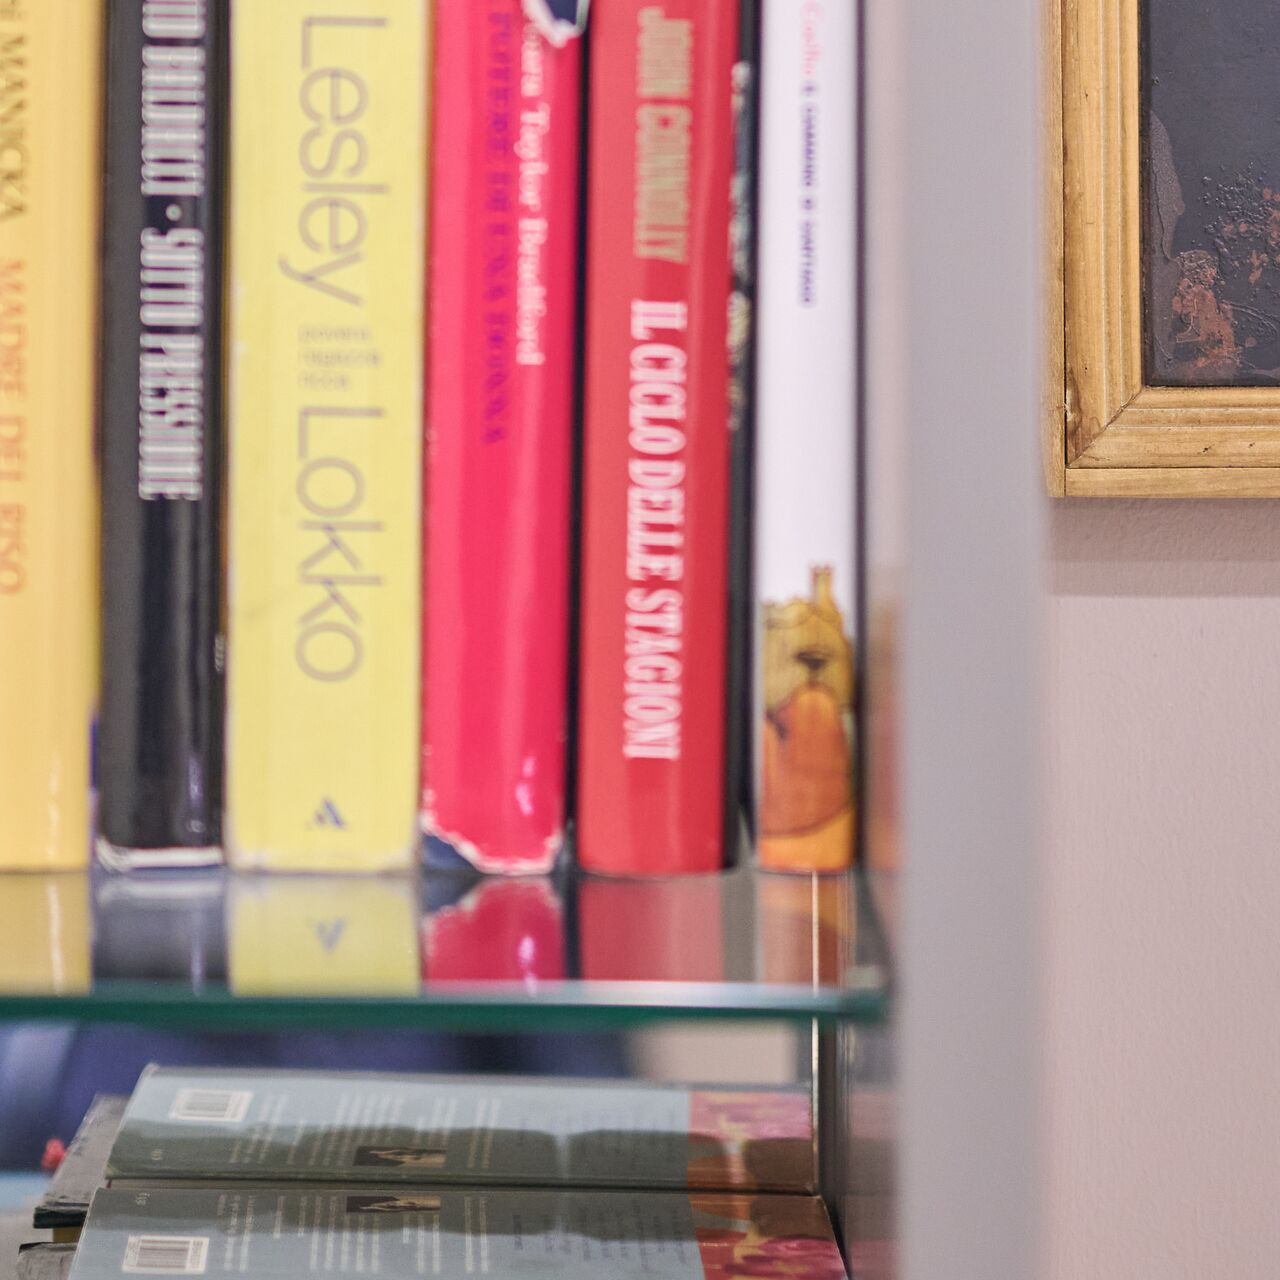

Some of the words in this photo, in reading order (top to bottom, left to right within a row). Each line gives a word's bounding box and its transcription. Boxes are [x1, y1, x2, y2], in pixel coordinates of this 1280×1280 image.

[277, 14, 392, 308] Lesley
[628, 298, 689, 340] IL
[627, 343, 688, 455] CICLO
[295, 405, 388, 684] Lokko
[624, 459, 687, 582] DELLE
[621, 588, 684, 759] STAGIONI
